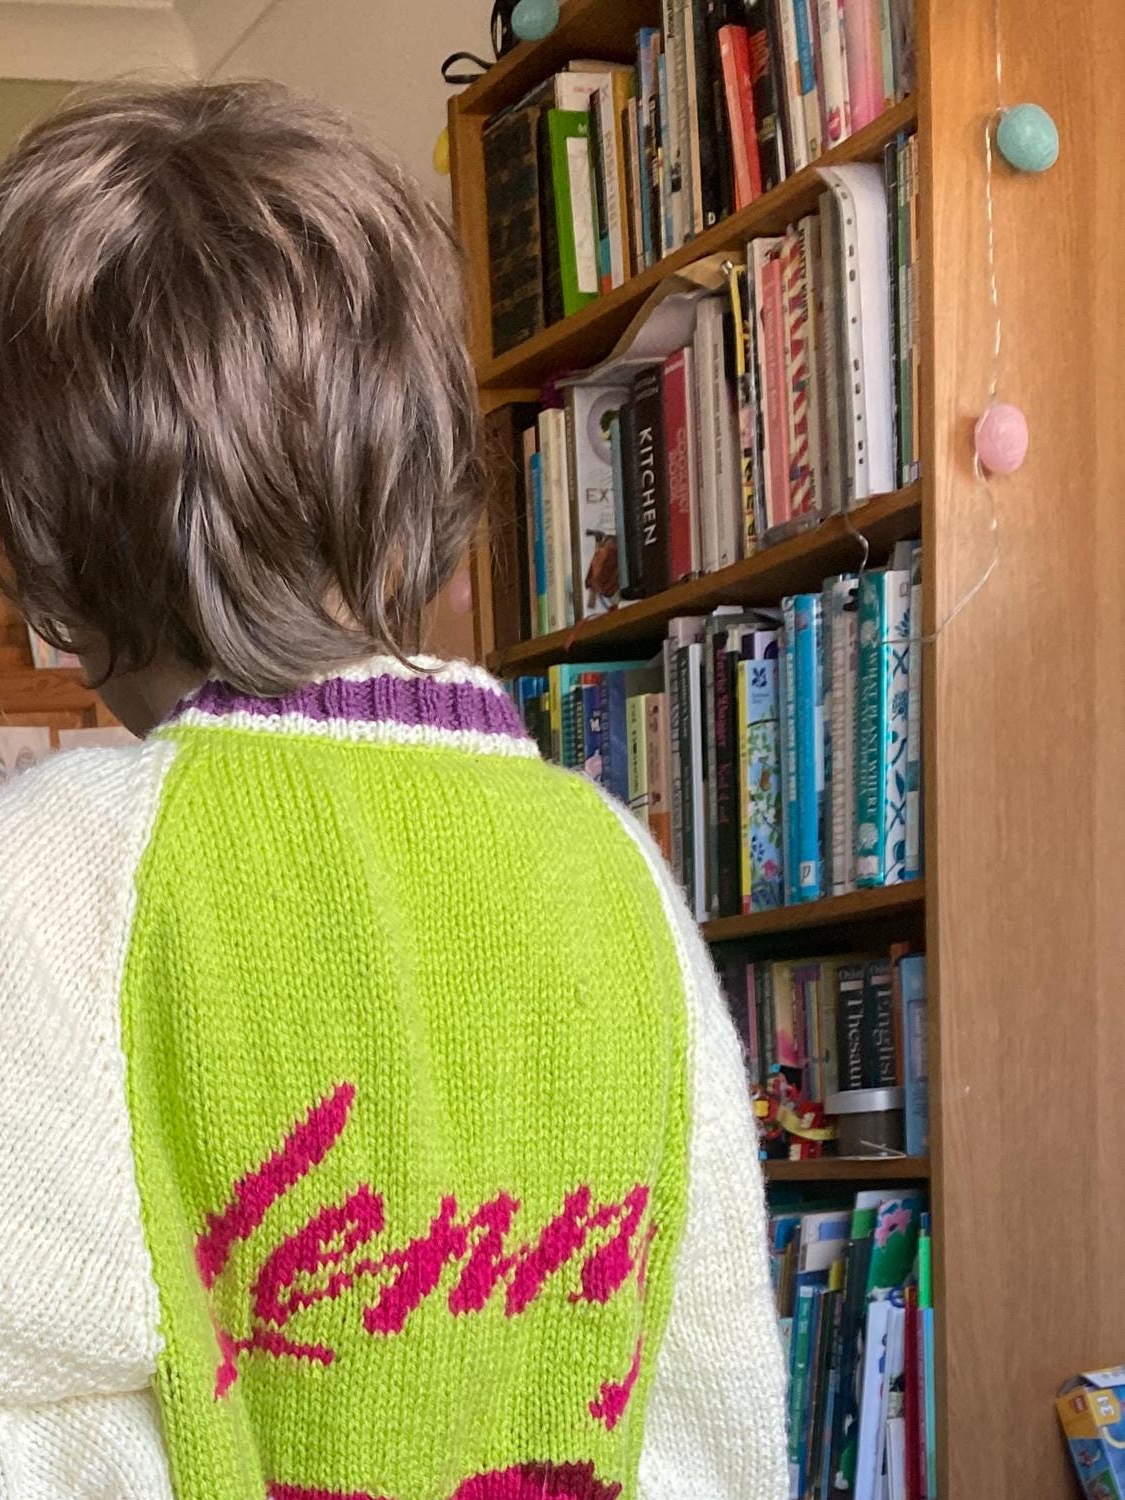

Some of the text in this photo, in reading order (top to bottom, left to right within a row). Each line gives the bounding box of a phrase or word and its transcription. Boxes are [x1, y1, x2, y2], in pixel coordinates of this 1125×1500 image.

[639, 427, 657, 546] KITCHEN
[866, 651, 878, 818] WHAT PLANT WHERE
